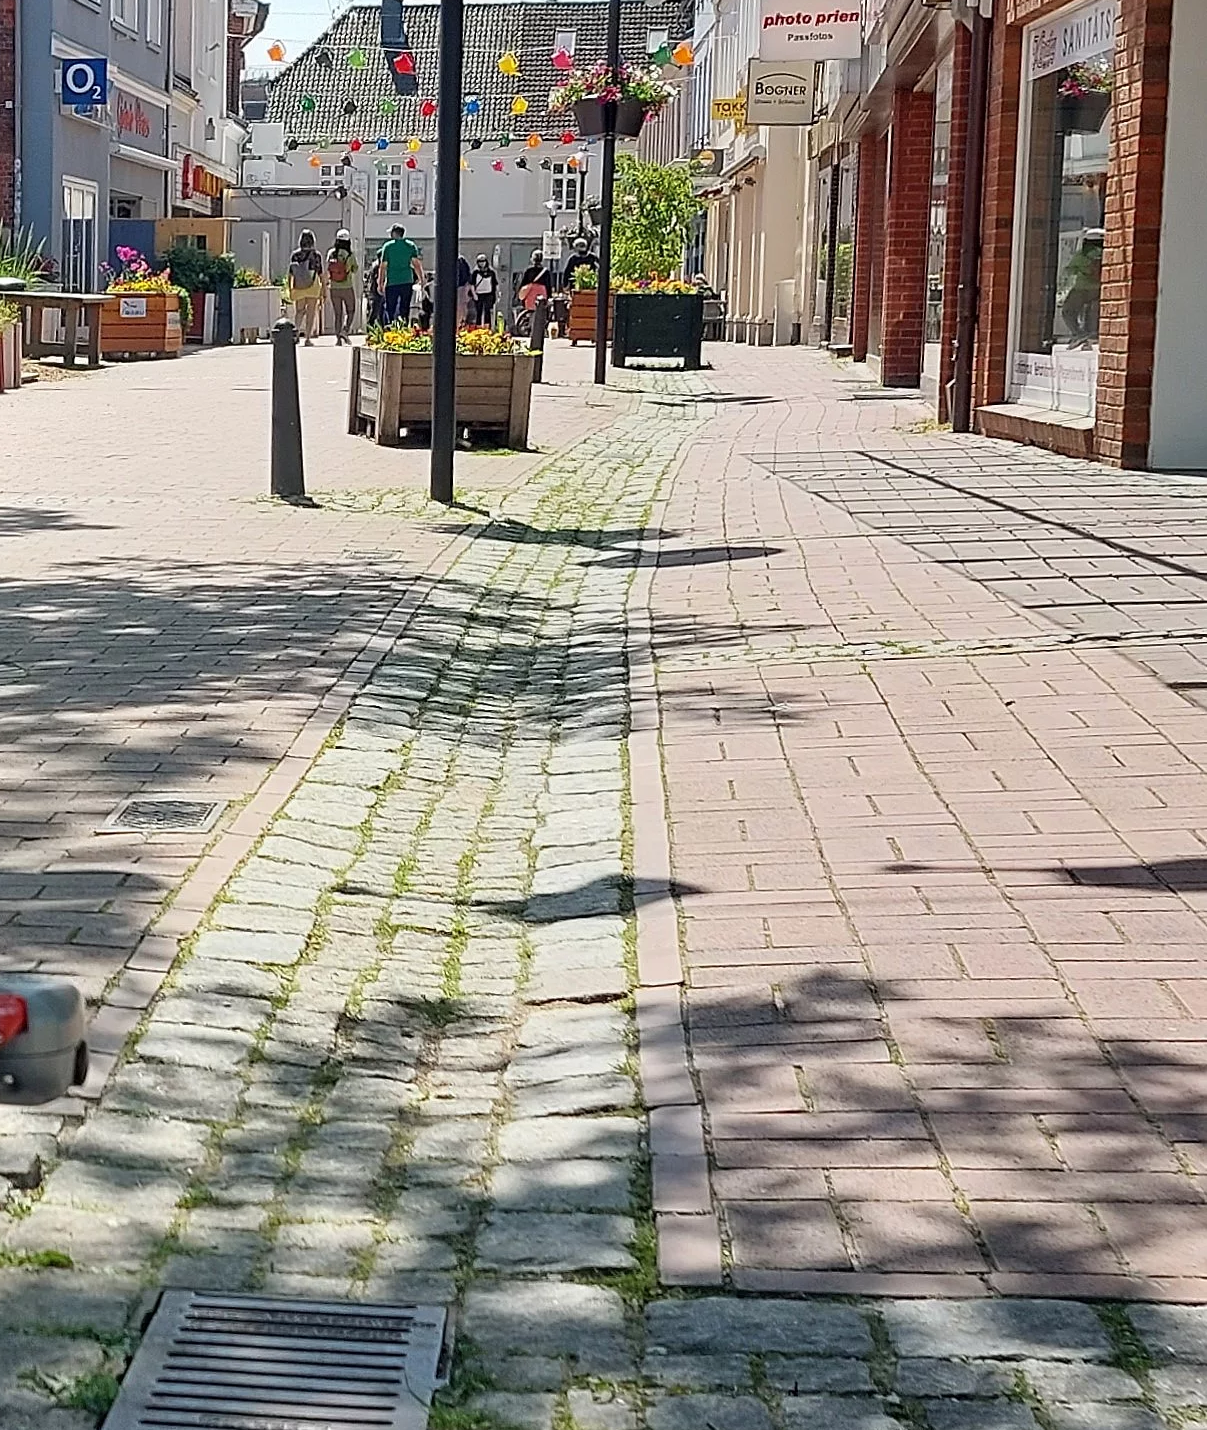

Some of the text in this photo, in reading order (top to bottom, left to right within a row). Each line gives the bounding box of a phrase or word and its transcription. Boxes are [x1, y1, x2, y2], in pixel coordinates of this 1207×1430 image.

[763, 9, 860, 29] photo prien
[787, 32, 833, 41] Passfotos
[755, 81, 807, 95] BOGNER
